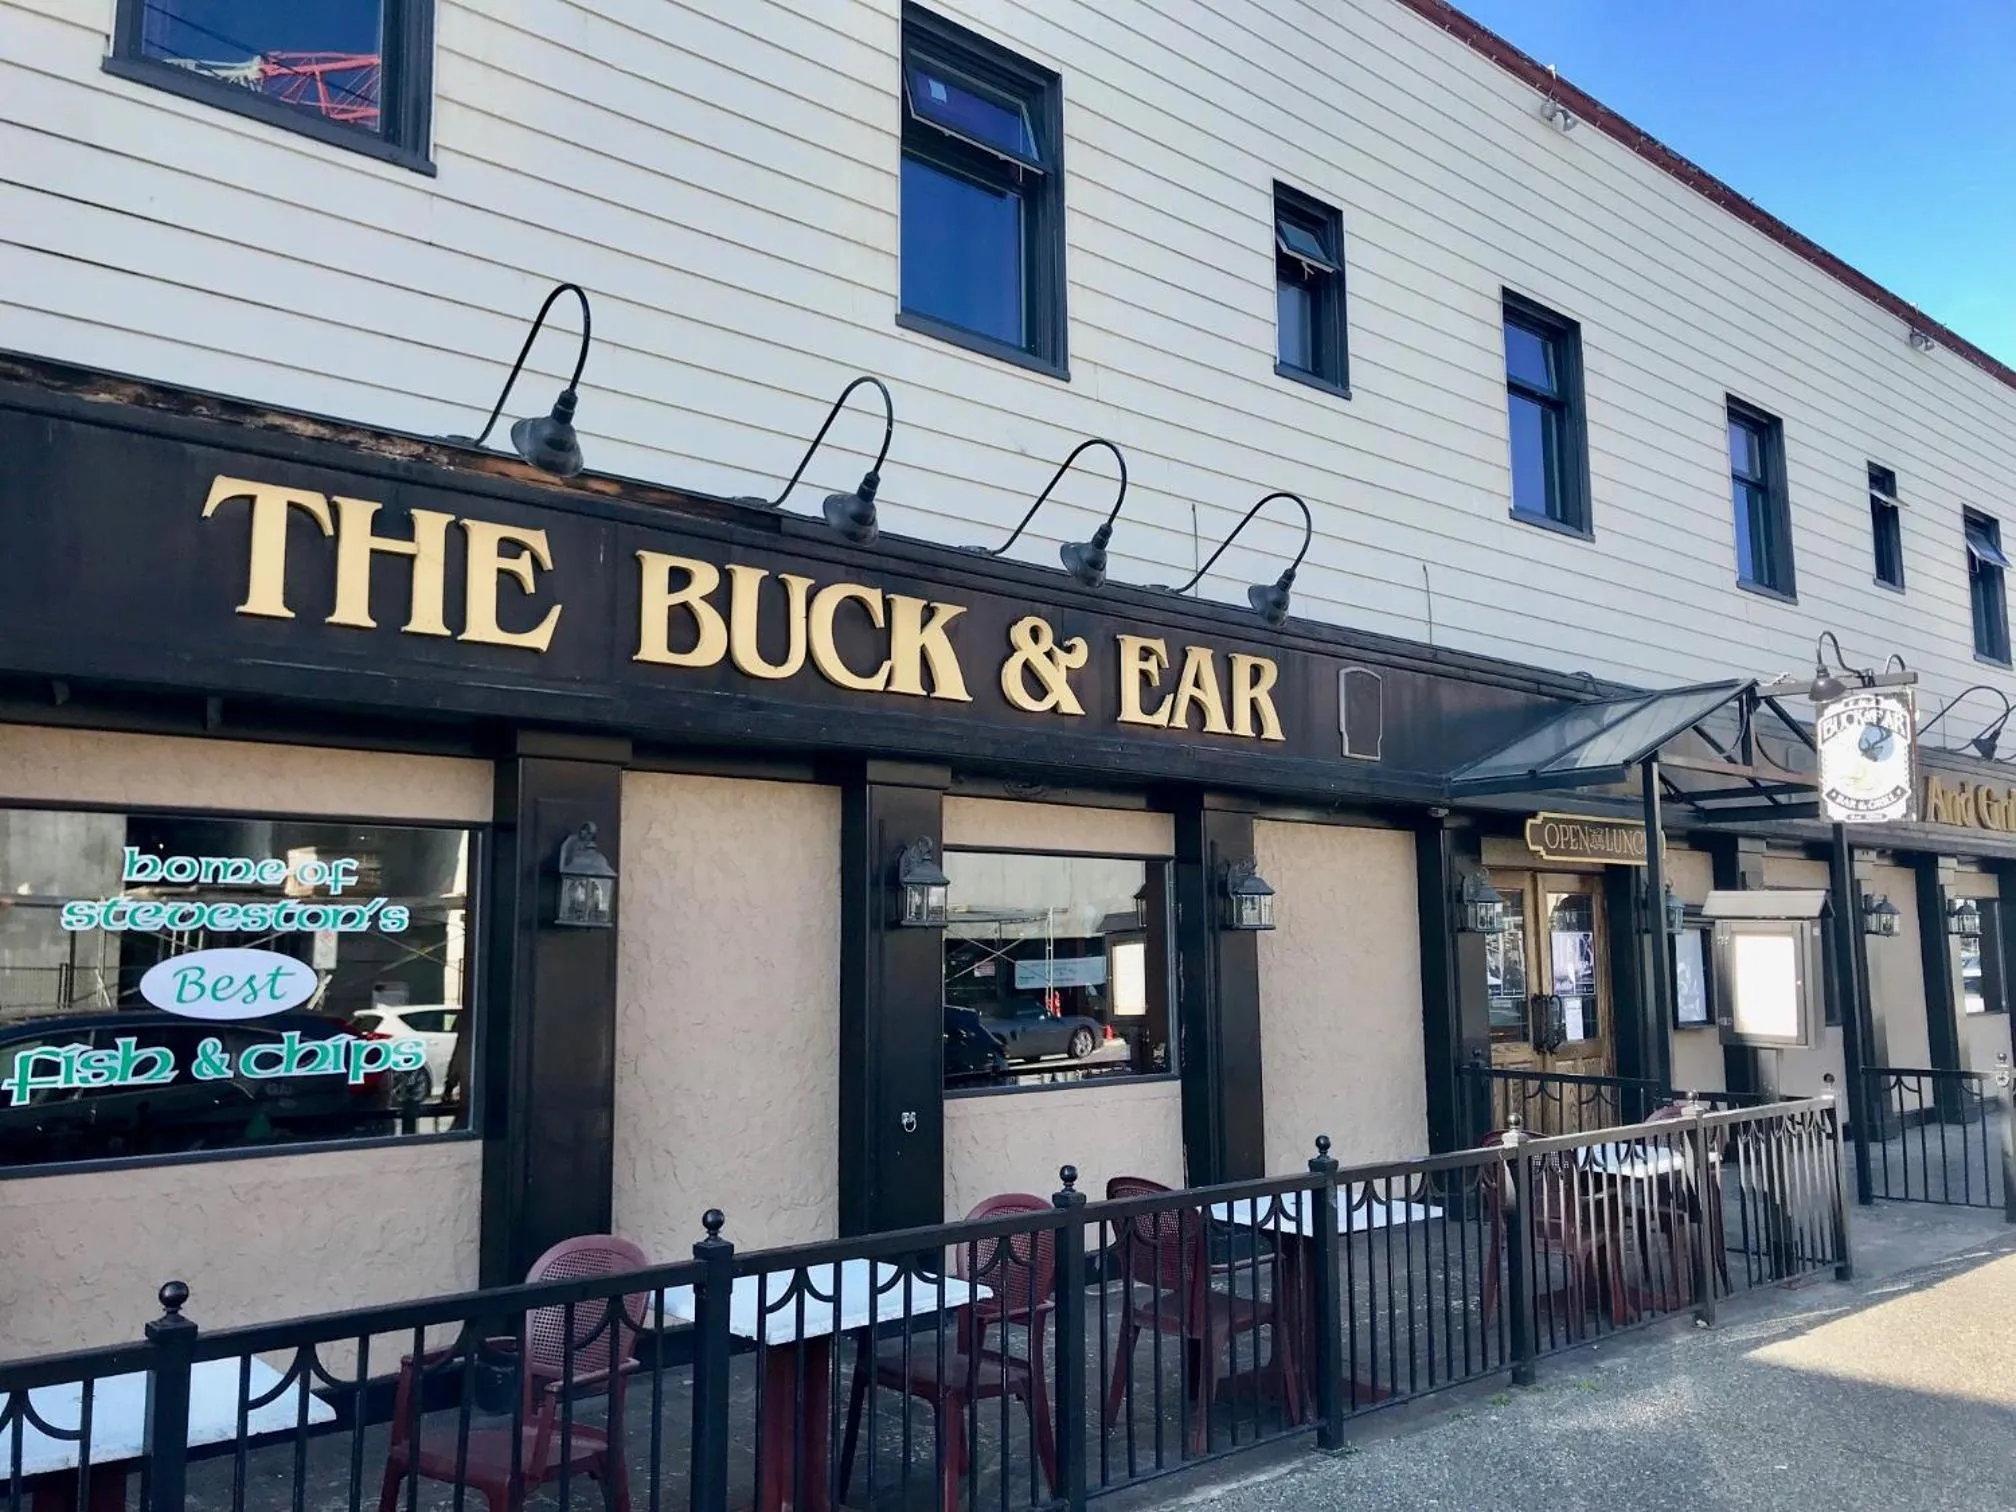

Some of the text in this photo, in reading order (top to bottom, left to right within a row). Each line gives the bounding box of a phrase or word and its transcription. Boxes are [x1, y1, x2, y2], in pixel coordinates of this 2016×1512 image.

[201, 474, 1286, 742] THE BUCK & EAR
[1822, 710, 1865, 740] BUCK
[1926, 774, 1977, 828] And
[1544, 822, 1592, 854] OPEN
[1605, 827, 1648, 857] LUNC
[122, 846, 359, 896] home of
[60, 897, 409, 933] steveston's
[172, 964, 300, 1006] Best
[1, 1030, 427, 1107] fish & chips
